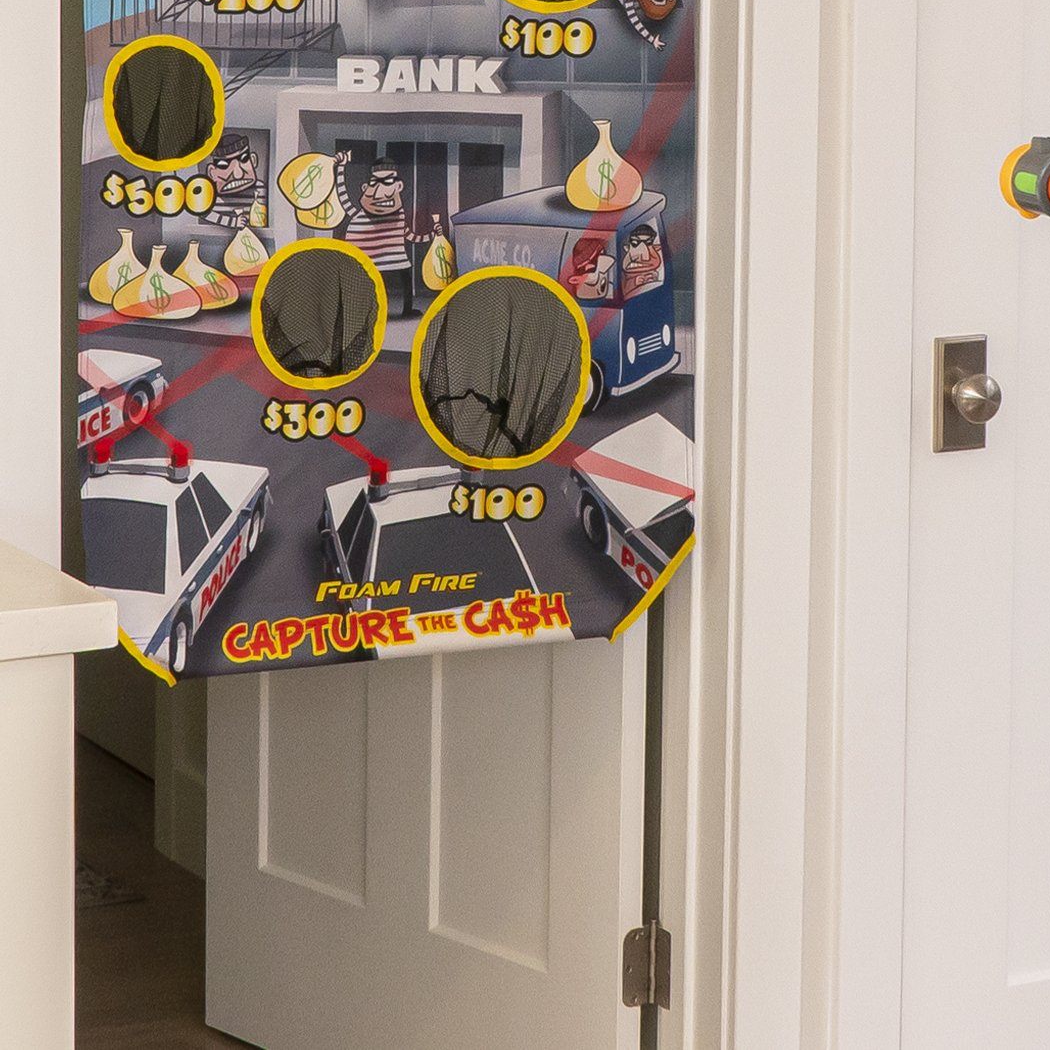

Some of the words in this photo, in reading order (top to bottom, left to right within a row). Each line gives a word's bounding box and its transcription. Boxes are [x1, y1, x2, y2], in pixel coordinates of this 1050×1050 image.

[500, 17, 595, 58] $100
[336, 57, 504, 94] BANK
[101, 172, 215, 218] $500
[263, 397, 364, 442] $300
[449, 484, 546, 522] $100
[199, 535, 242, 624] POLICE
[315, 581, 400, 602] FOAM
[222, 606, 415, 663] CAPTURE
[417, 613, 457, 634] THE
[464, 589, 573, 639] CA$H
